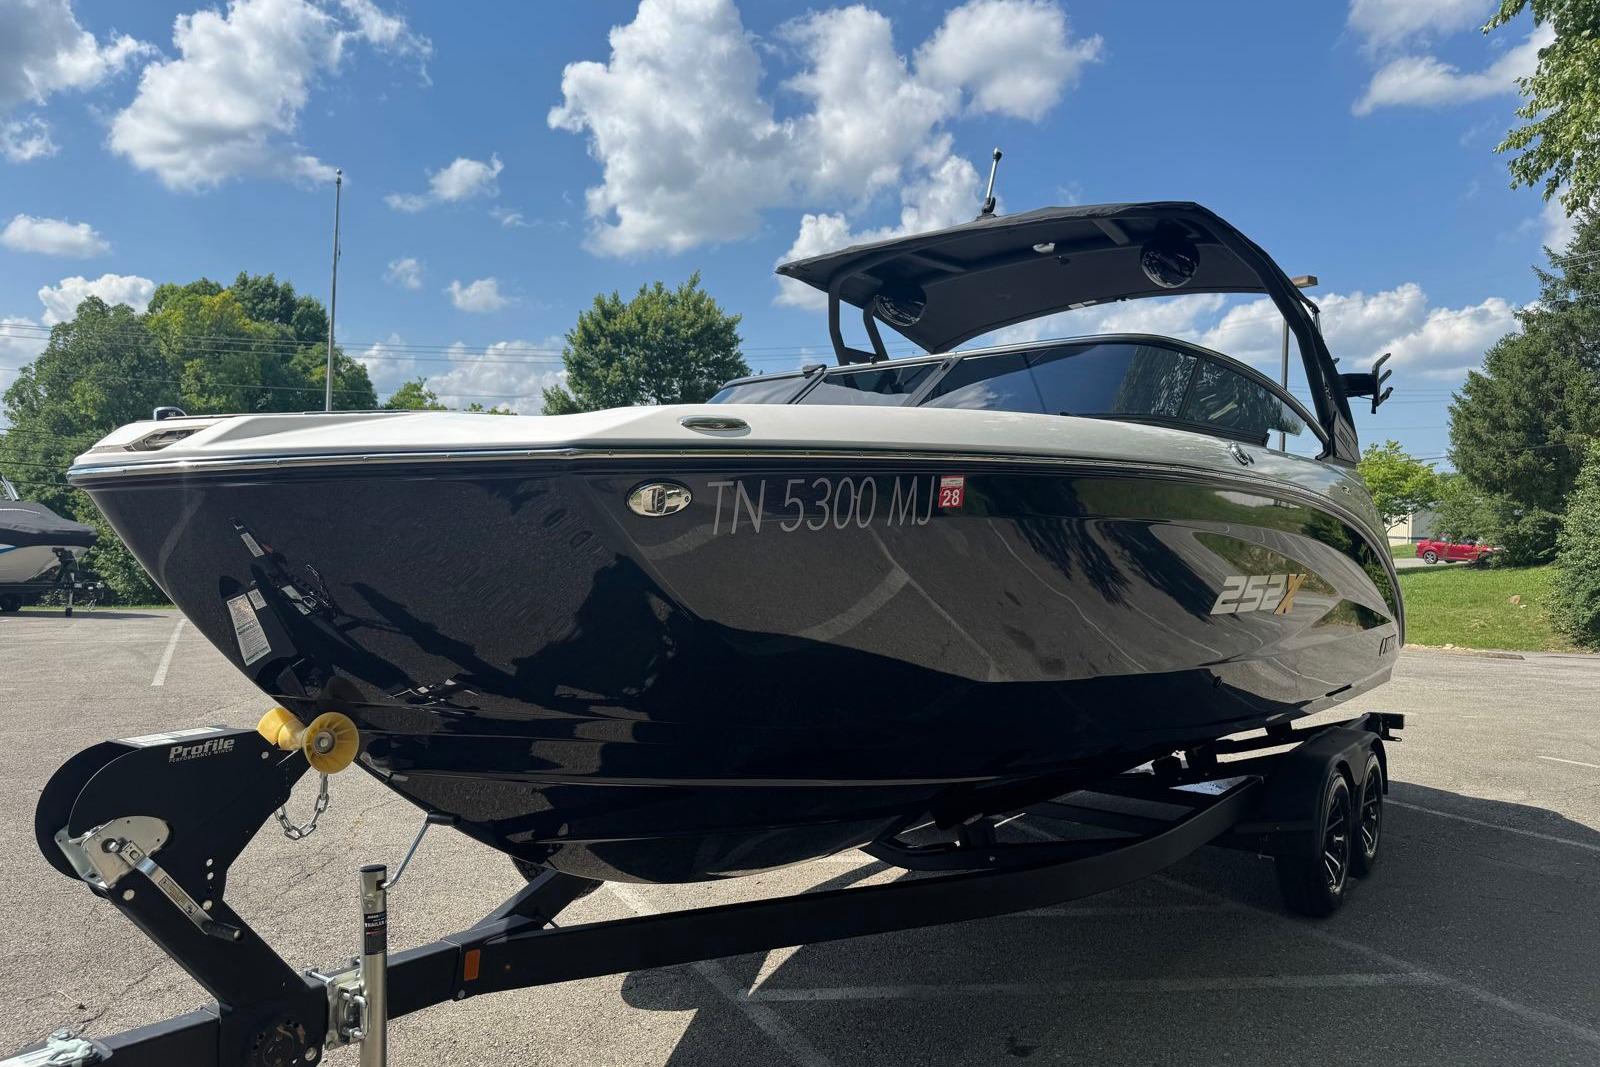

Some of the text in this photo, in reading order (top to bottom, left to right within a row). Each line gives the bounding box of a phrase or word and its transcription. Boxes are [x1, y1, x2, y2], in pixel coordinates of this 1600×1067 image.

[707, 475, 936, 535] TN 5300 MJ
[942, 489, 960, 506] 28
[1210, 573, 1306, 615] 252X
[169, 738, 235, 759] Profile
